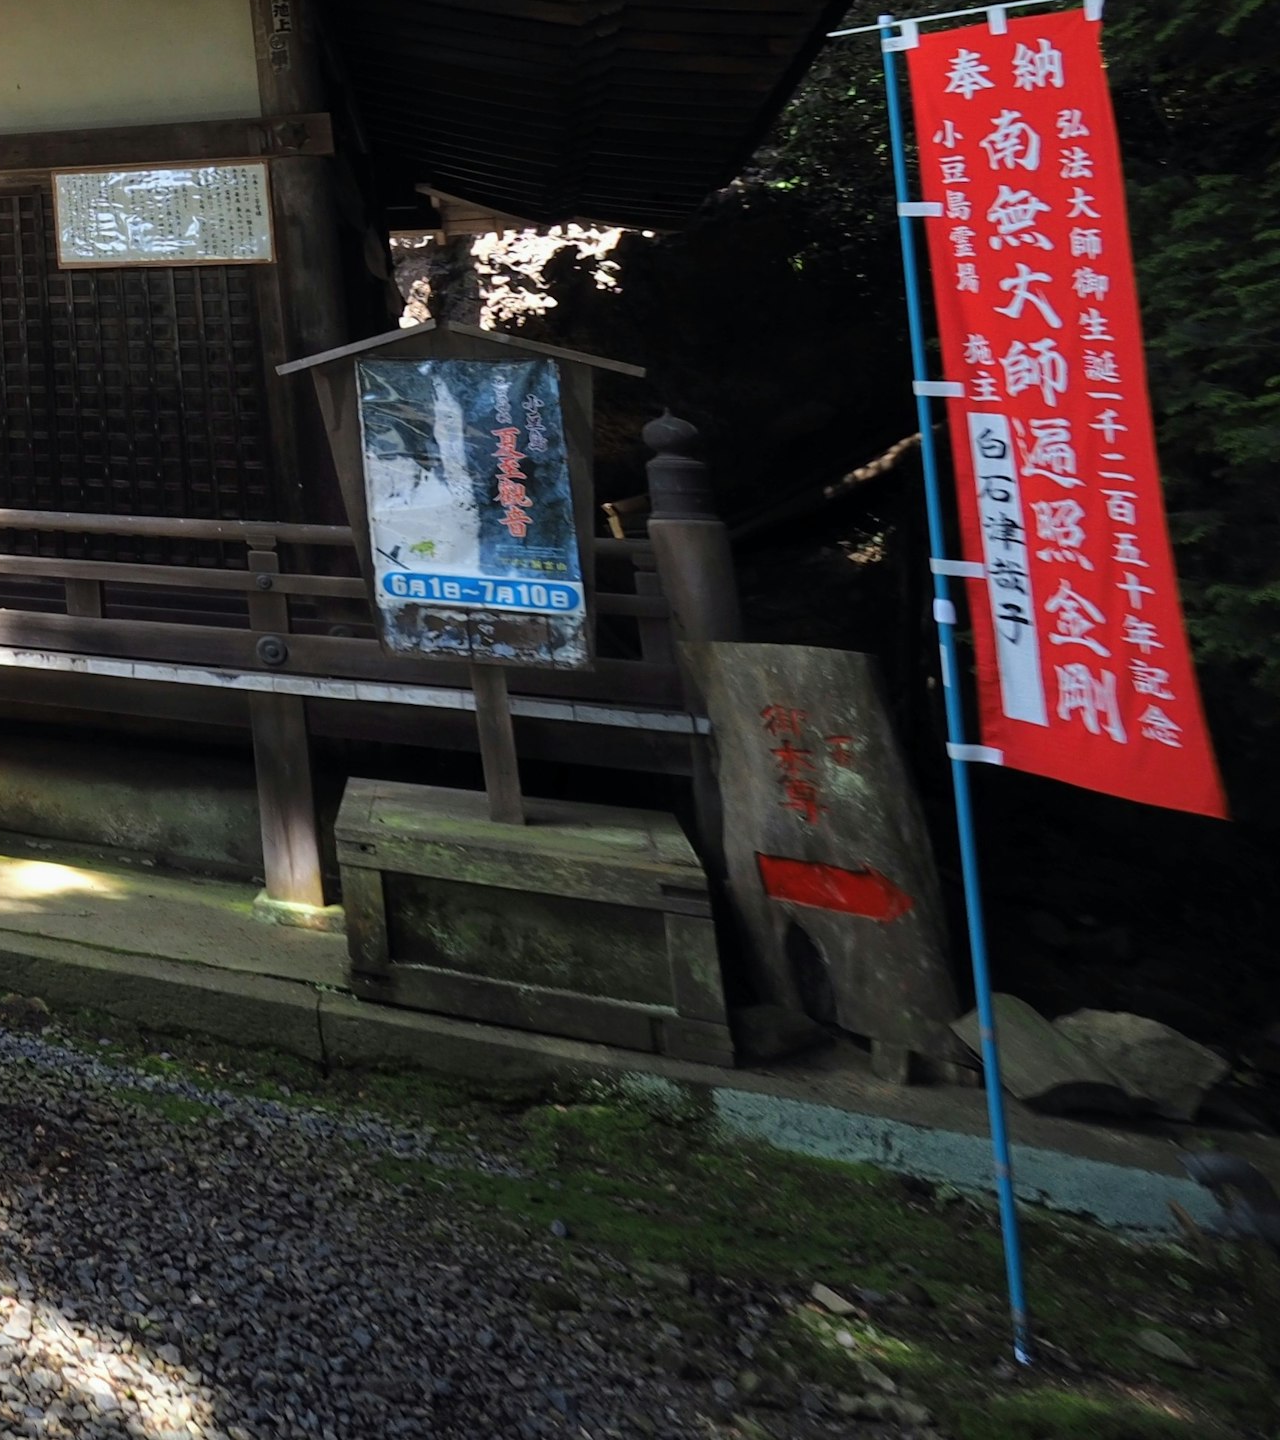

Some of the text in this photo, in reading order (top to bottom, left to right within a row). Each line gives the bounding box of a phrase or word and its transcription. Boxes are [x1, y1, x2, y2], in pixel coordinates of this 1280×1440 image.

[944, 37, 1066, 100] 奉納
[978, 108, 1129, 746] 南無大師遍照金剛
[1054, 107, 1184, 749] 弘法大師御生誕一千二百五十年記念
